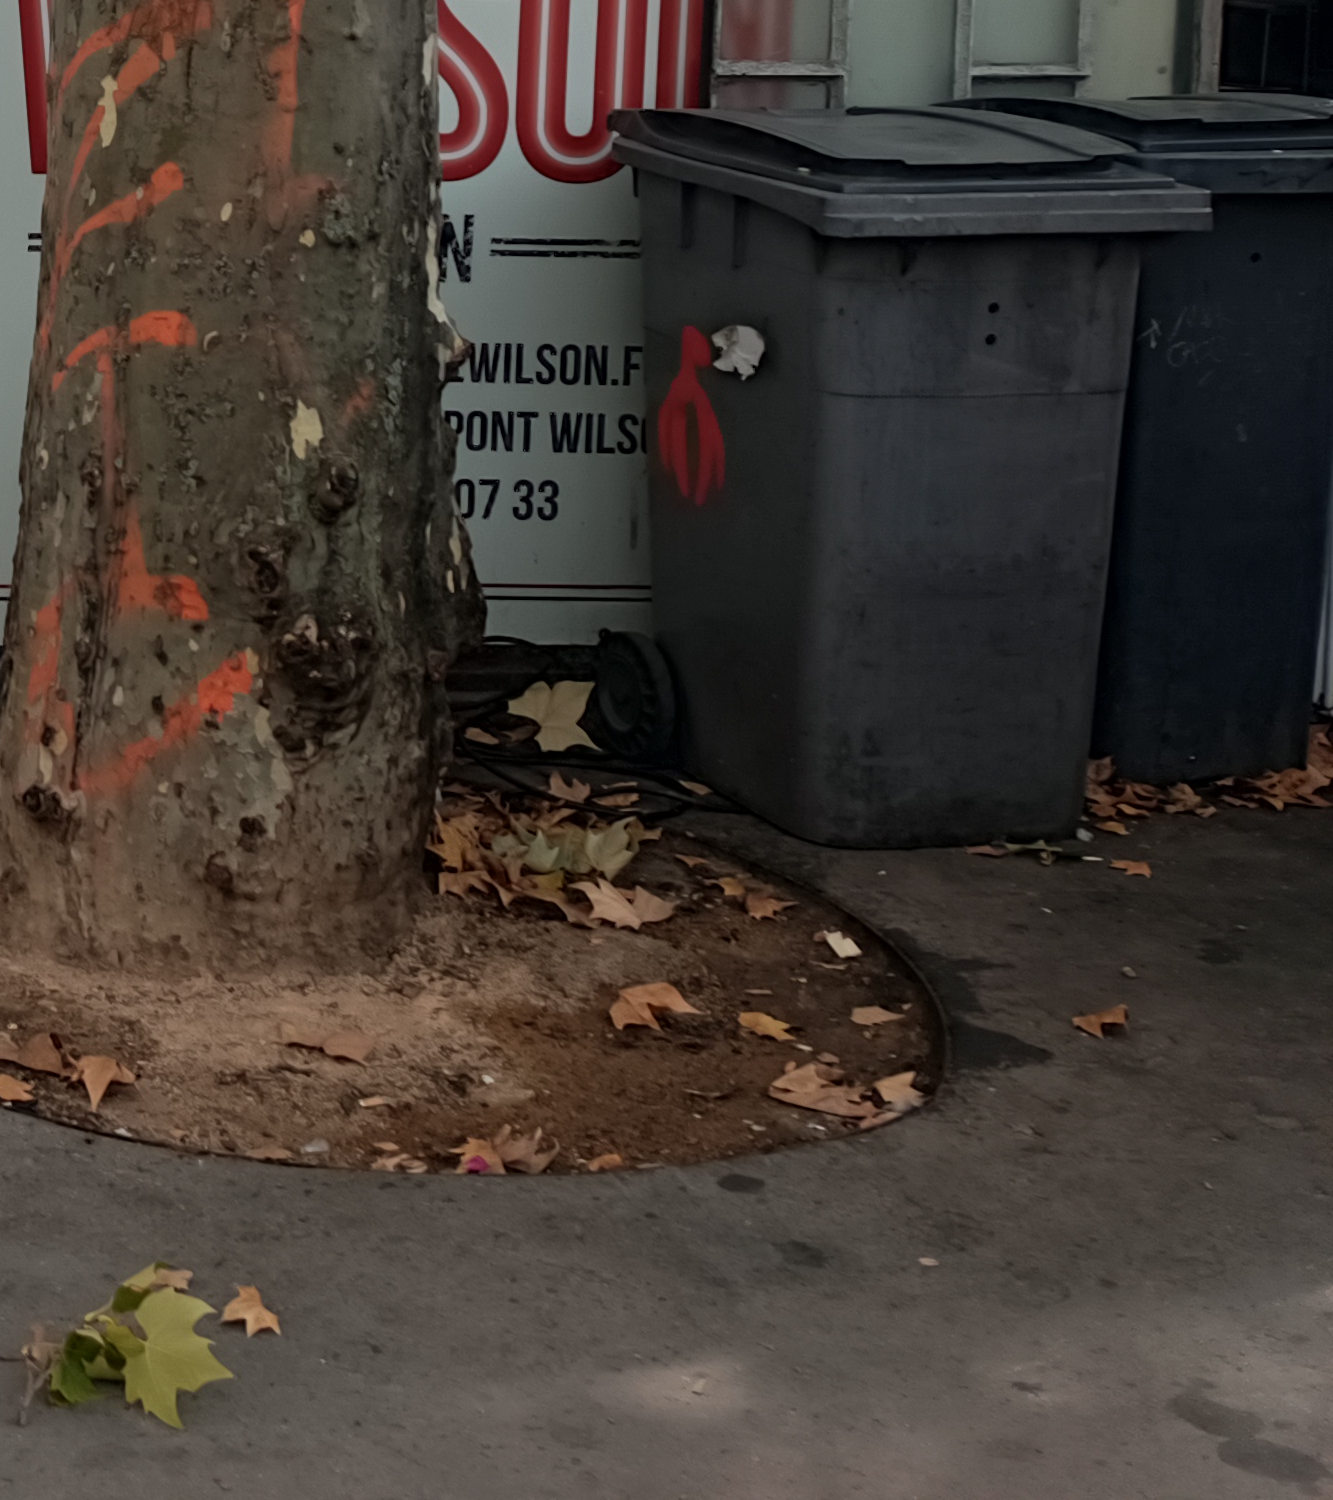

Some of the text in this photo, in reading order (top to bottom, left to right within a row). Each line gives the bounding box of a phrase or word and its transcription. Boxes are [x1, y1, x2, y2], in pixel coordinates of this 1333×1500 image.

[443, 410, 539, 453] PONT
[454, 478, 560, 521] 07 33
